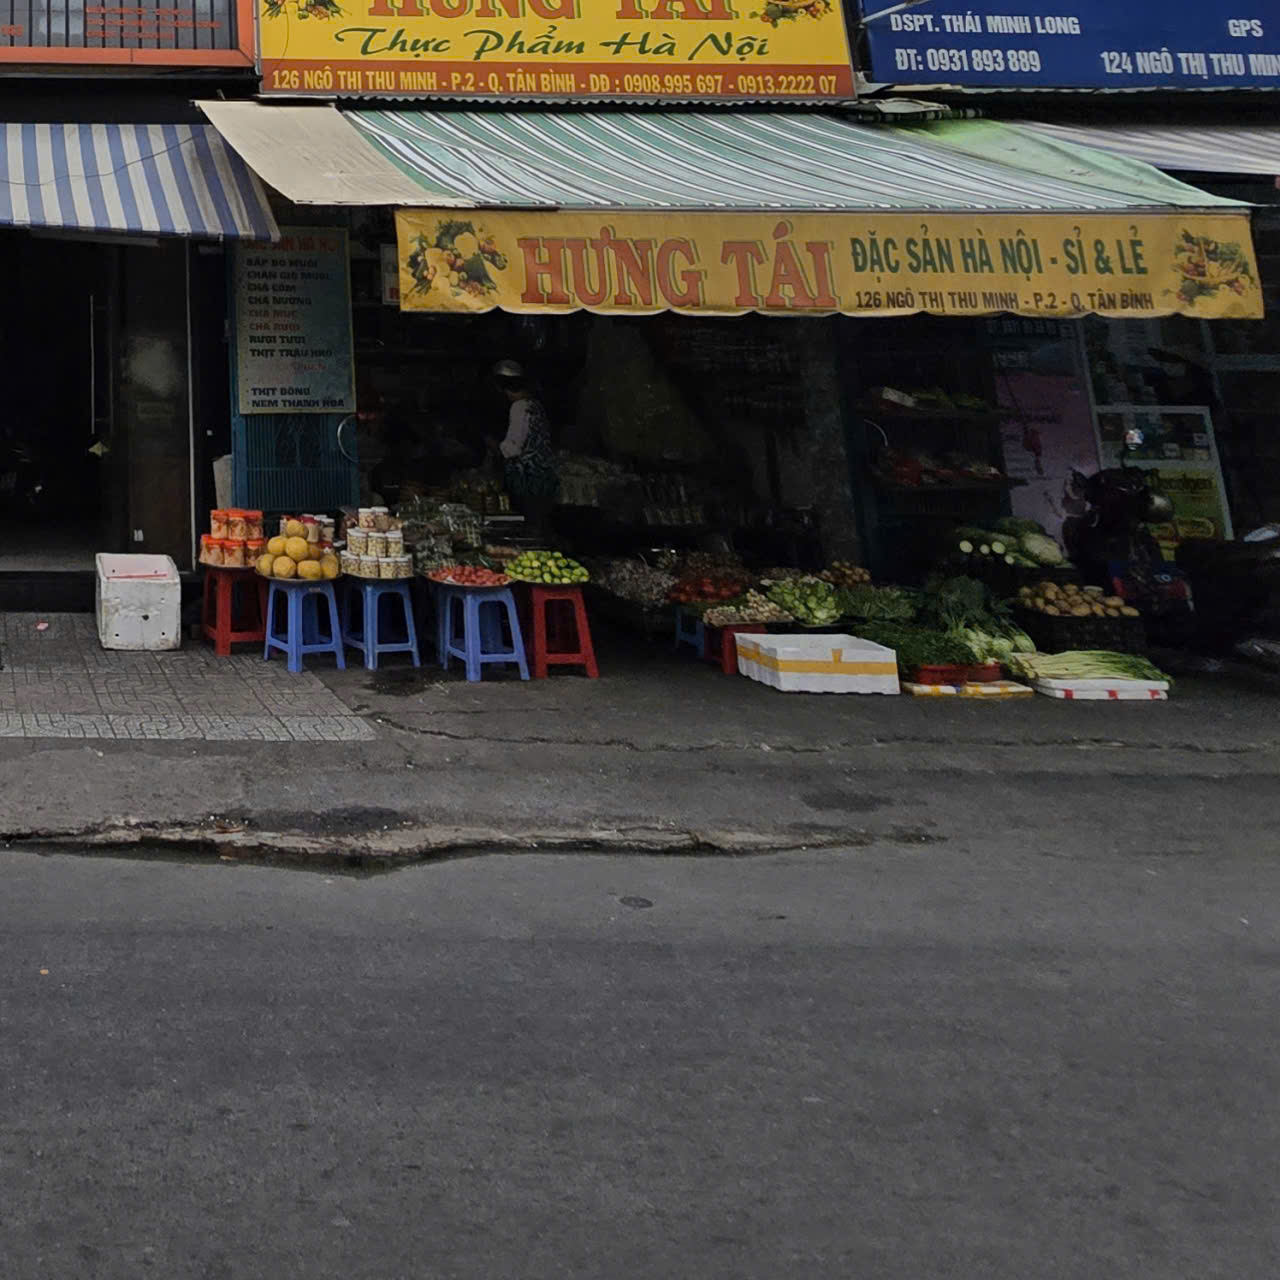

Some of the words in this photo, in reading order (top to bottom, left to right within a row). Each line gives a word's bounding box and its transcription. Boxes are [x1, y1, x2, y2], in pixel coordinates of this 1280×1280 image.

[891, 14, 940, 33] DSPT.
[941, 11, 982, 34] THÁI
[985, 15, 1031, 35] MINH
[1035, 16, 1081, 36] LONG
[1227, 19, 1264, 37] GPS
[333, 27, 452, 59] Thực
[463, 23, 586, 62] Phẩm
[599, 31, 676, 57] Hà
[687, 31, 770, 62] Nội
[895, 47, 923, 71] ĐT:
[926, 48, 968, 72] 0931
[971, 49, 1005, 72] 893
[1006, 49, 1041, 73] 889
[1100, 51, 1133, 74] 124
[1135, 48, 1174, 75] NGÔ
[1177, 52, 1208, 79] THỊ
[1208, 53, 1245, 76] THU
[1251, 54, 1280, 76] MIN
[272, 69, 300, 89] 126
[303, 66, 334, 90] NGÔ
[337, 70, 362, 94] THỊ
[365, 70, 396, 91] THU
[399, 71, 438, 91] MINH
[450, 72, 476, 92] P.2
[488, 72, 504, 93] Q.
[506, 68, 537, 92] TÂN
[540, 68, 577, 93] BÌNH
[623, 73, 692, 94] 0908.995
[696, 74, 723, 94] 697
[737, 75, 816, 95] 0913.2222
[819, 75, 837, 94] 07
[517, 223, 707, 308] HƯNG
[720, 220, 842, 310] TÁI
[851, 230, 900, 284] ĐẶC
[907, 224, 955, 273] SẢN
[960, 228, 994, 273] HÀ
[1001, 228, 1044, 282] NỘI
[1063, 225, 1090, 275] SỈ
[1095, 239, 1114, 275] &
[1121, 224, 1149, 275] LẺ
[856, 291, 881, 308] 126
[886, 288, 916, 309] NGÔ
[918, 291, 946, 313] THỊ
[950, 291, 978, 309] THU
[982, 291, 1019, 309] MINH
[1033, 291, 1058, 309] P.2
[1071, 292, 1087, 310] Q.
[1088, 288, 1117, 310] TÂN
[1120, 287, 1154, 311] BÌNH
